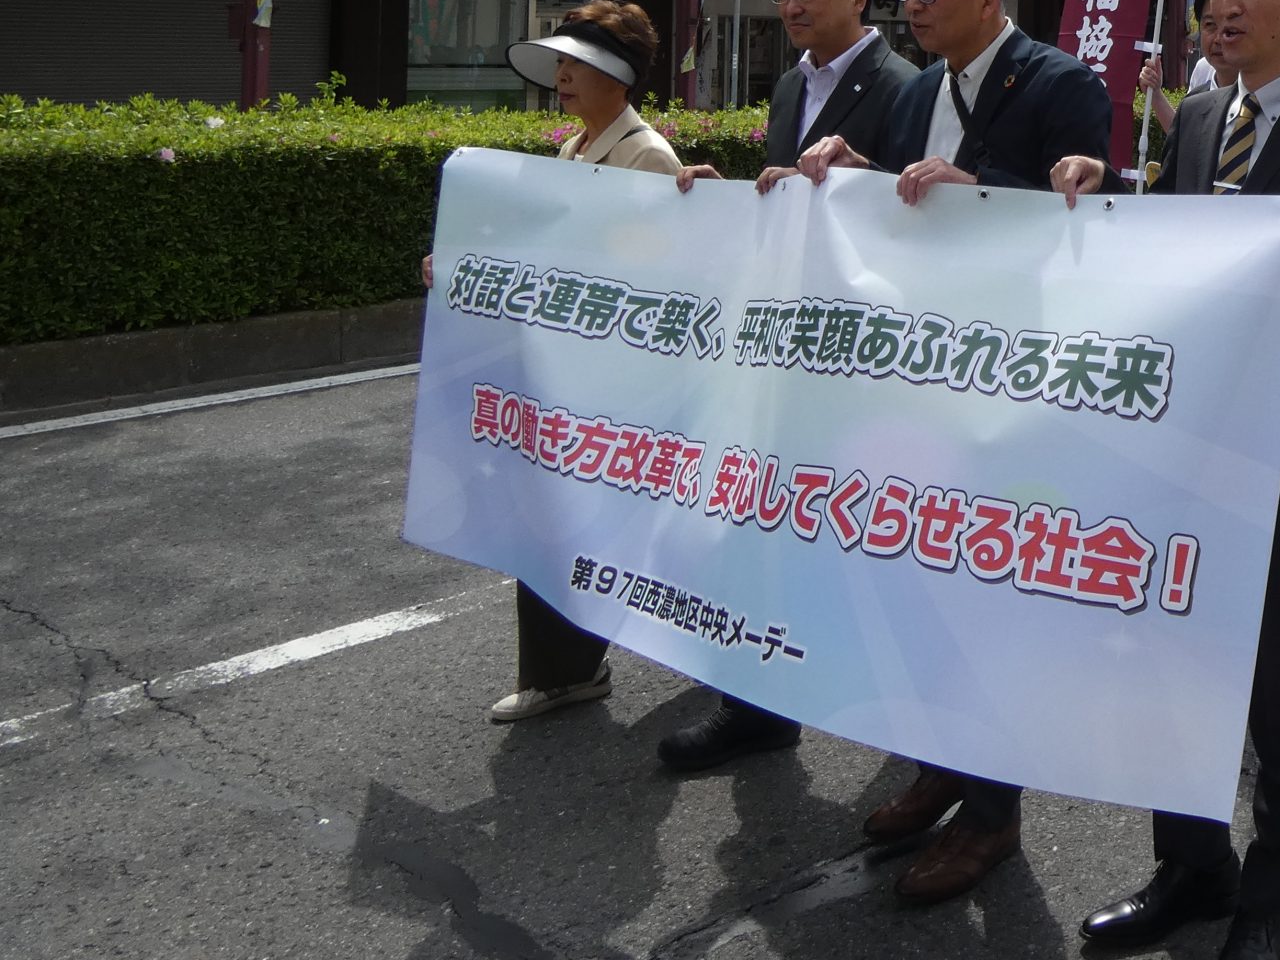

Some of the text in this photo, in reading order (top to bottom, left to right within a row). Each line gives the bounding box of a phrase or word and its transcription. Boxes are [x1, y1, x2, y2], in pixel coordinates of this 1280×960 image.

[448, 255, 1174, 420] 対話と連帯で築く、平和で笑顔あふれる未来
[471, 384, 1200, 615] 真の働き方改革で、安心してくらせる社会！
